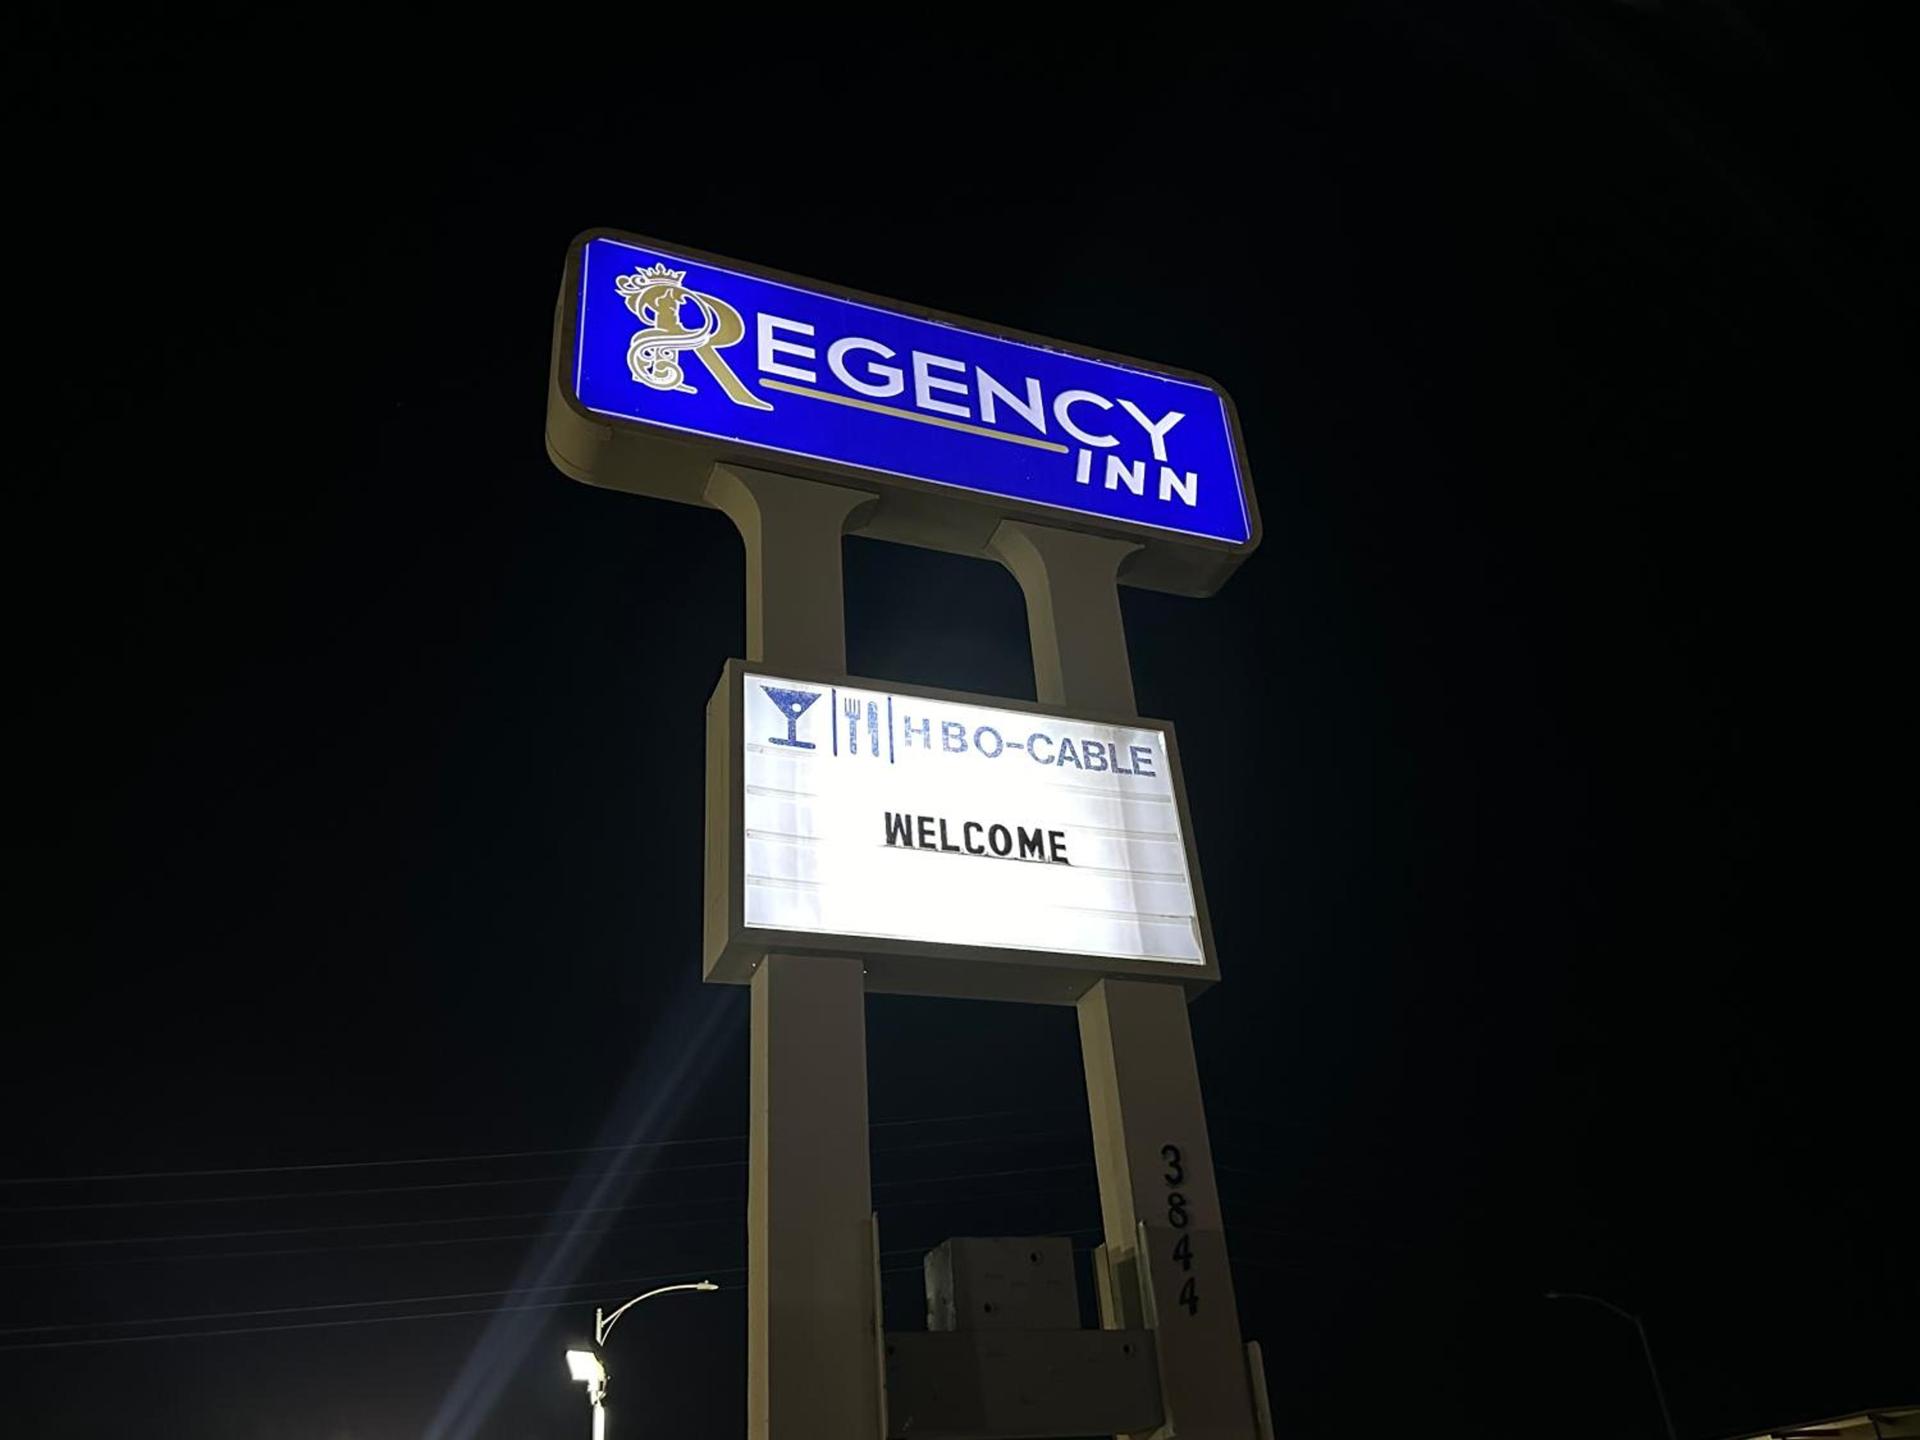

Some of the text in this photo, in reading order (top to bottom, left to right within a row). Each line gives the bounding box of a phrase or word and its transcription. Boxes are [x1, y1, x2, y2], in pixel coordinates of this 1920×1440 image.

[615, 263, 1185, 460] REGENCY
[1076, 449, 1197, 506] INN
[885, 812, 1070, 865] WELCOME
[1162, 1145, 1200, 1315] 3844
